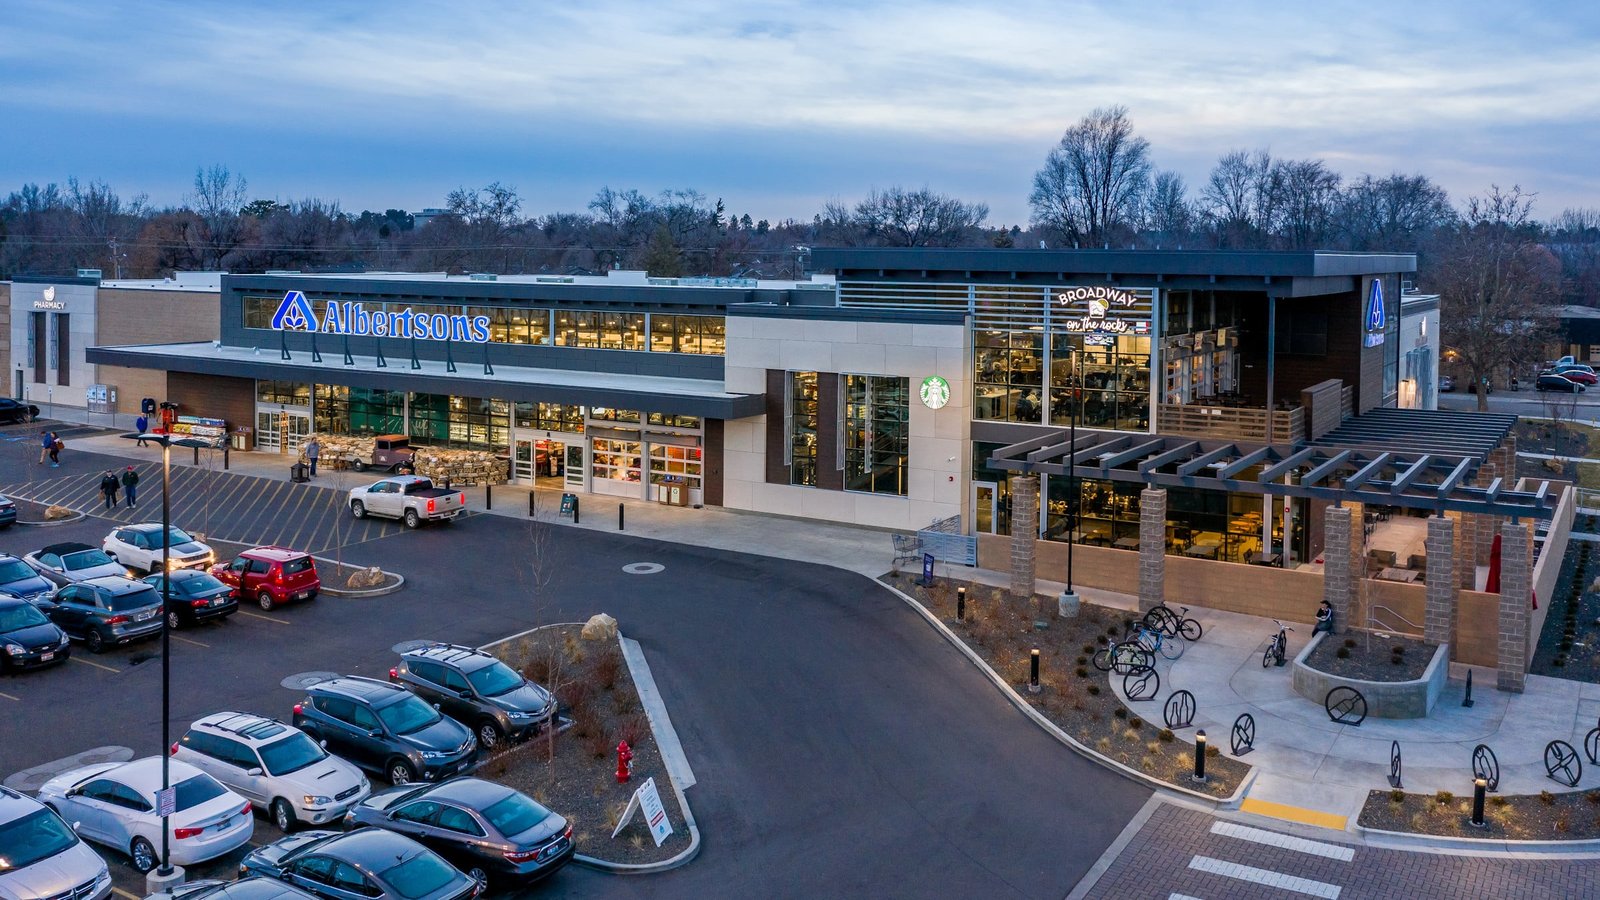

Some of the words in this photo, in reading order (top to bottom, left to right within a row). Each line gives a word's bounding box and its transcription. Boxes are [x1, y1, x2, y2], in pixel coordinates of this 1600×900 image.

[33, 301, 65, 310] PHARMACY
[1058, 287, 1137, 307] BROADWAY
[322, 300, 490, 344] Albertsons
[1066, 320, 1080, 329] on
[1080, 316, 1099, 332] the
[1099, 318, 1128, 333] rocks
